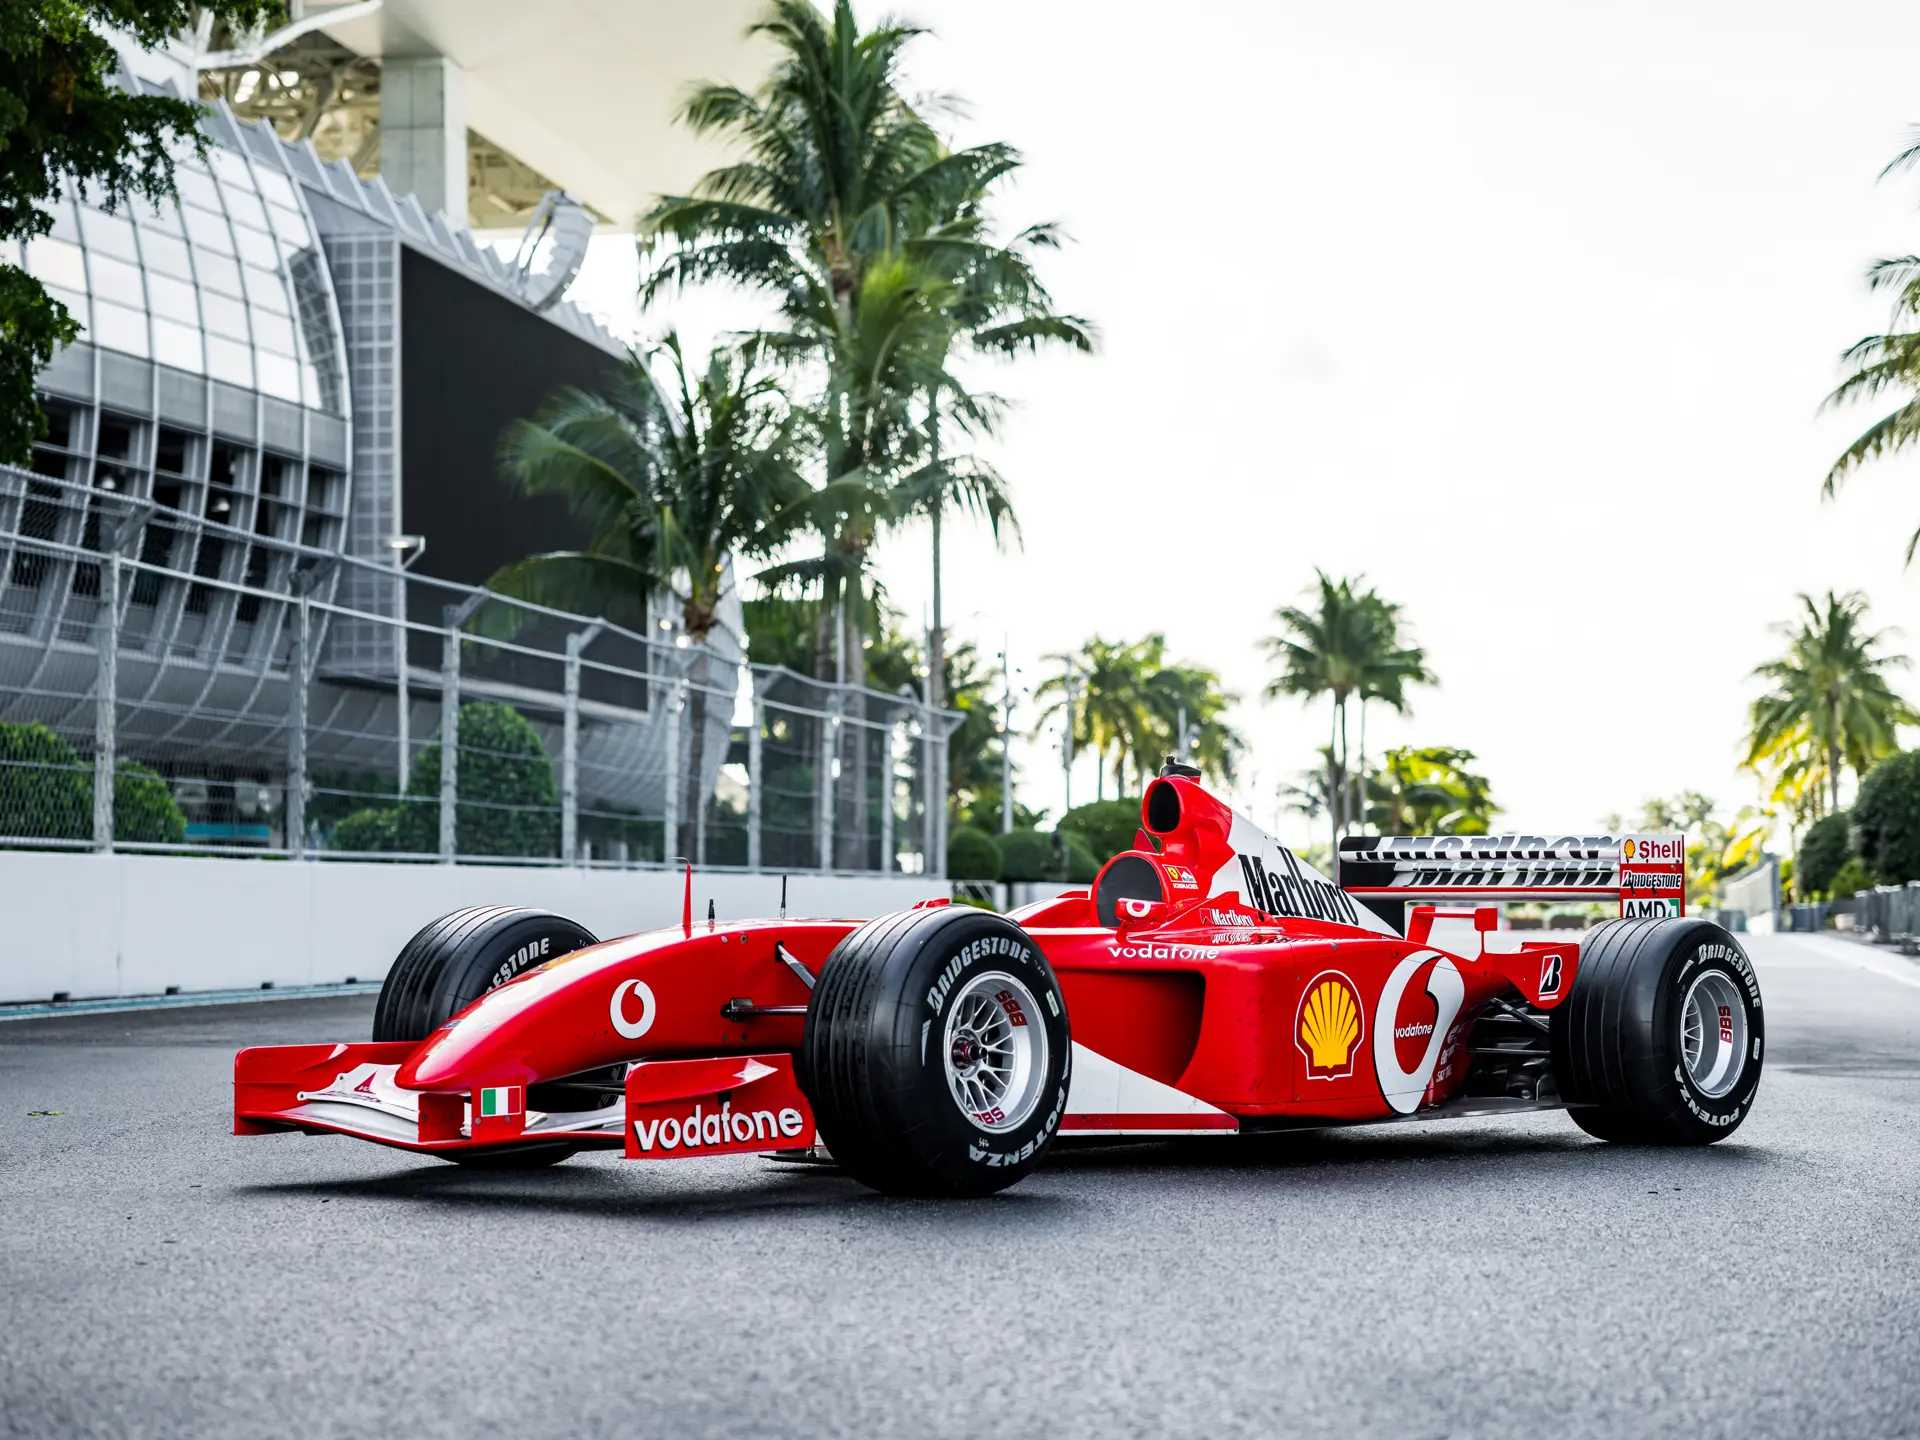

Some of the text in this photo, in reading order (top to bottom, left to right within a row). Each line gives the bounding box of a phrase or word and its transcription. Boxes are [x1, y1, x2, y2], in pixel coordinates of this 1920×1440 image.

[1639, 840, 1680, 859] Shell
[1238, 846, 1359, 926] Marlboro
[1621, 870, 1682, 889] BRIDGESTONE
[1211, 908, 1255, 927] Marlboro
[1626, 901, 1666, 918] AMD
[1107, 943, 1220, 961] vodafone
[927, 936, 1031, 1017] BRIDGESTONE
[1698, 943, 1761, 1008] BRIDGESTONE
[994, 989, 1028, 1027] BBS
[1718, 1005, 1733, 1044] BBS
[1395, 1022, 1433, 1039] vodafone
[1674, 1064, 1740, 1126] POTENZA
[633, 1101, 803, 1151] vodafone
[969, 1085, 1066, 1167] POTENZA
